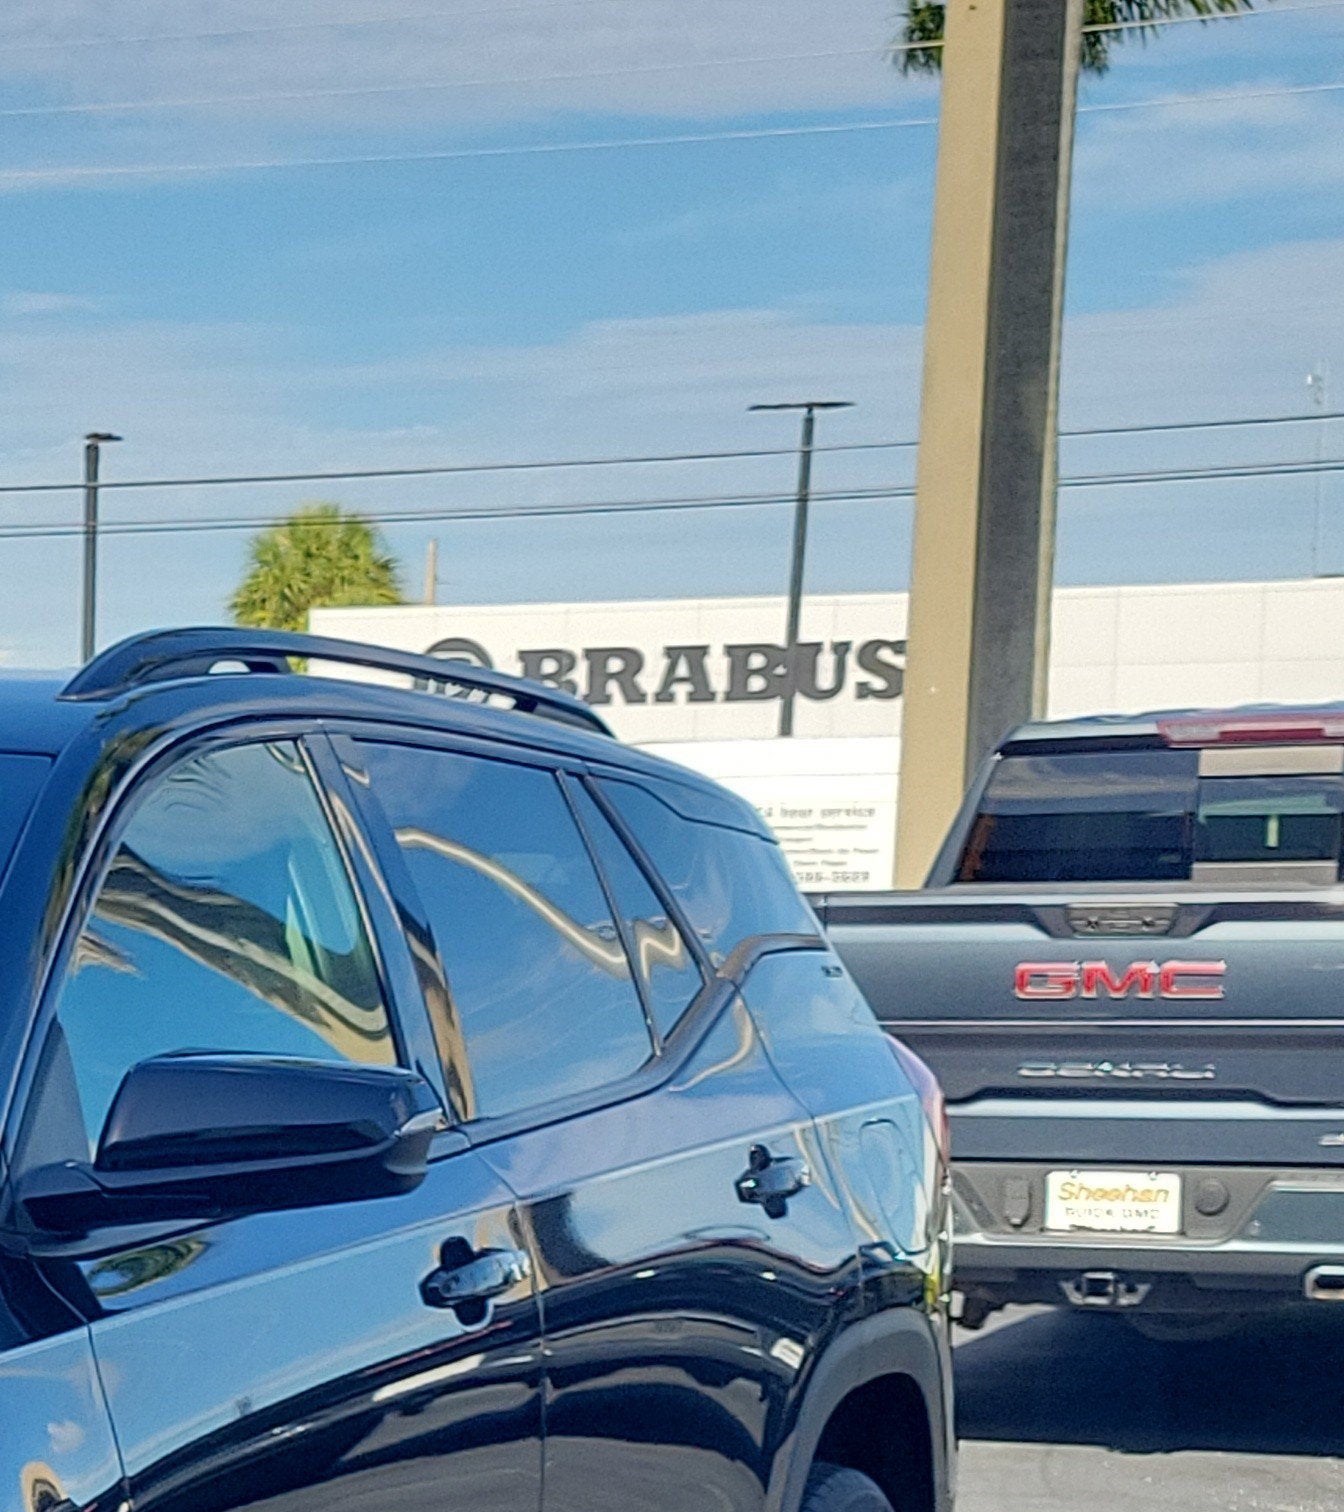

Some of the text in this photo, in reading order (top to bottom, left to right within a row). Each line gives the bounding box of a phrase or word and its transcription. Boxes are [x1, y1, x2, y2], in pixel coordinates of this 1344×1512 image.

[518, 639, 907, 704] BRABUS
[1014, 959, 1227, 1000] GMC
[1058, 1181, 1170, 1203] Sheehan
